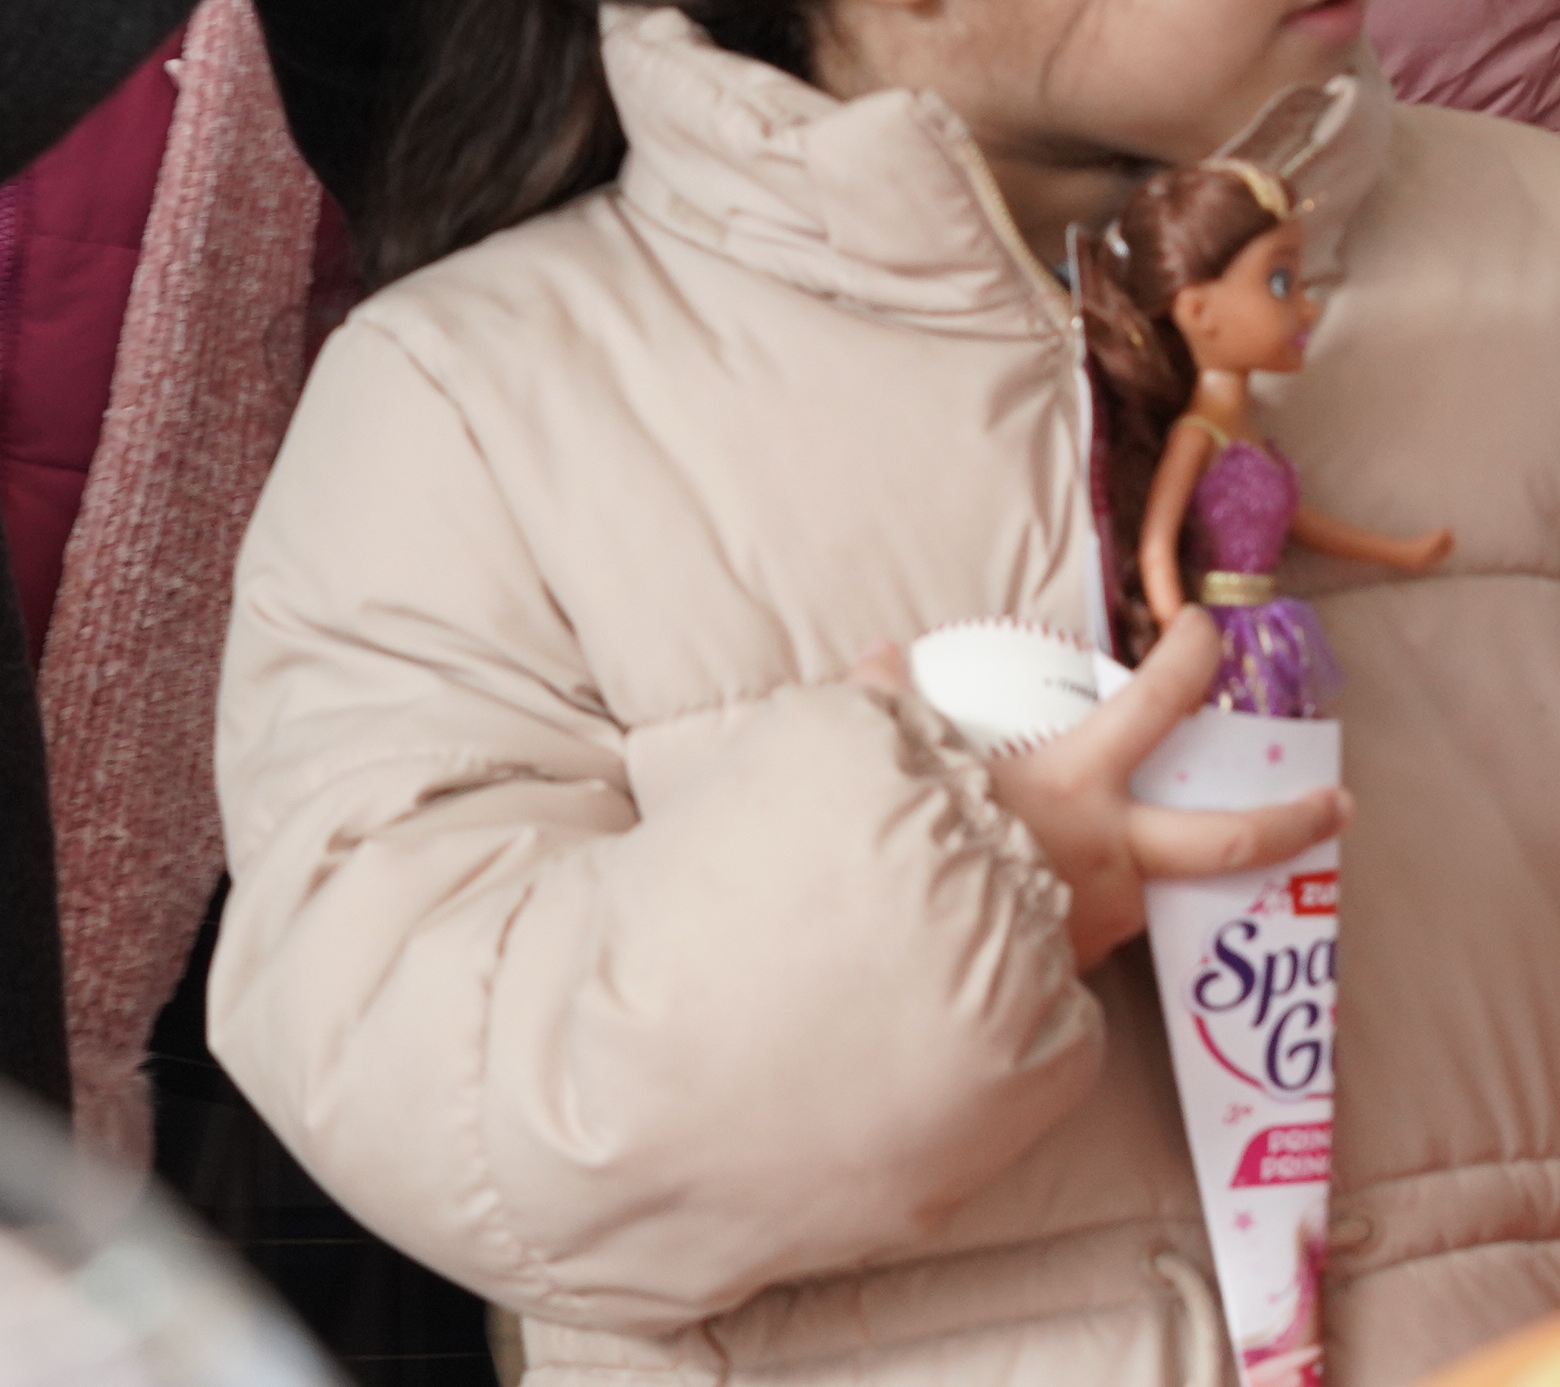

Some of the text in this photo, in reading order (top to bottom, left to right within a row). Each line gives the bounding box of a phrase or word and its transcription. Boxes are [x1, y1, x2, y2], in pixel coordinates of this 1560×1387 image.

[1299, 880, 1339, 911] ZU
[1193, 919, 1339, 1029] Spa
[1264, 999, 1337, 1092] G
